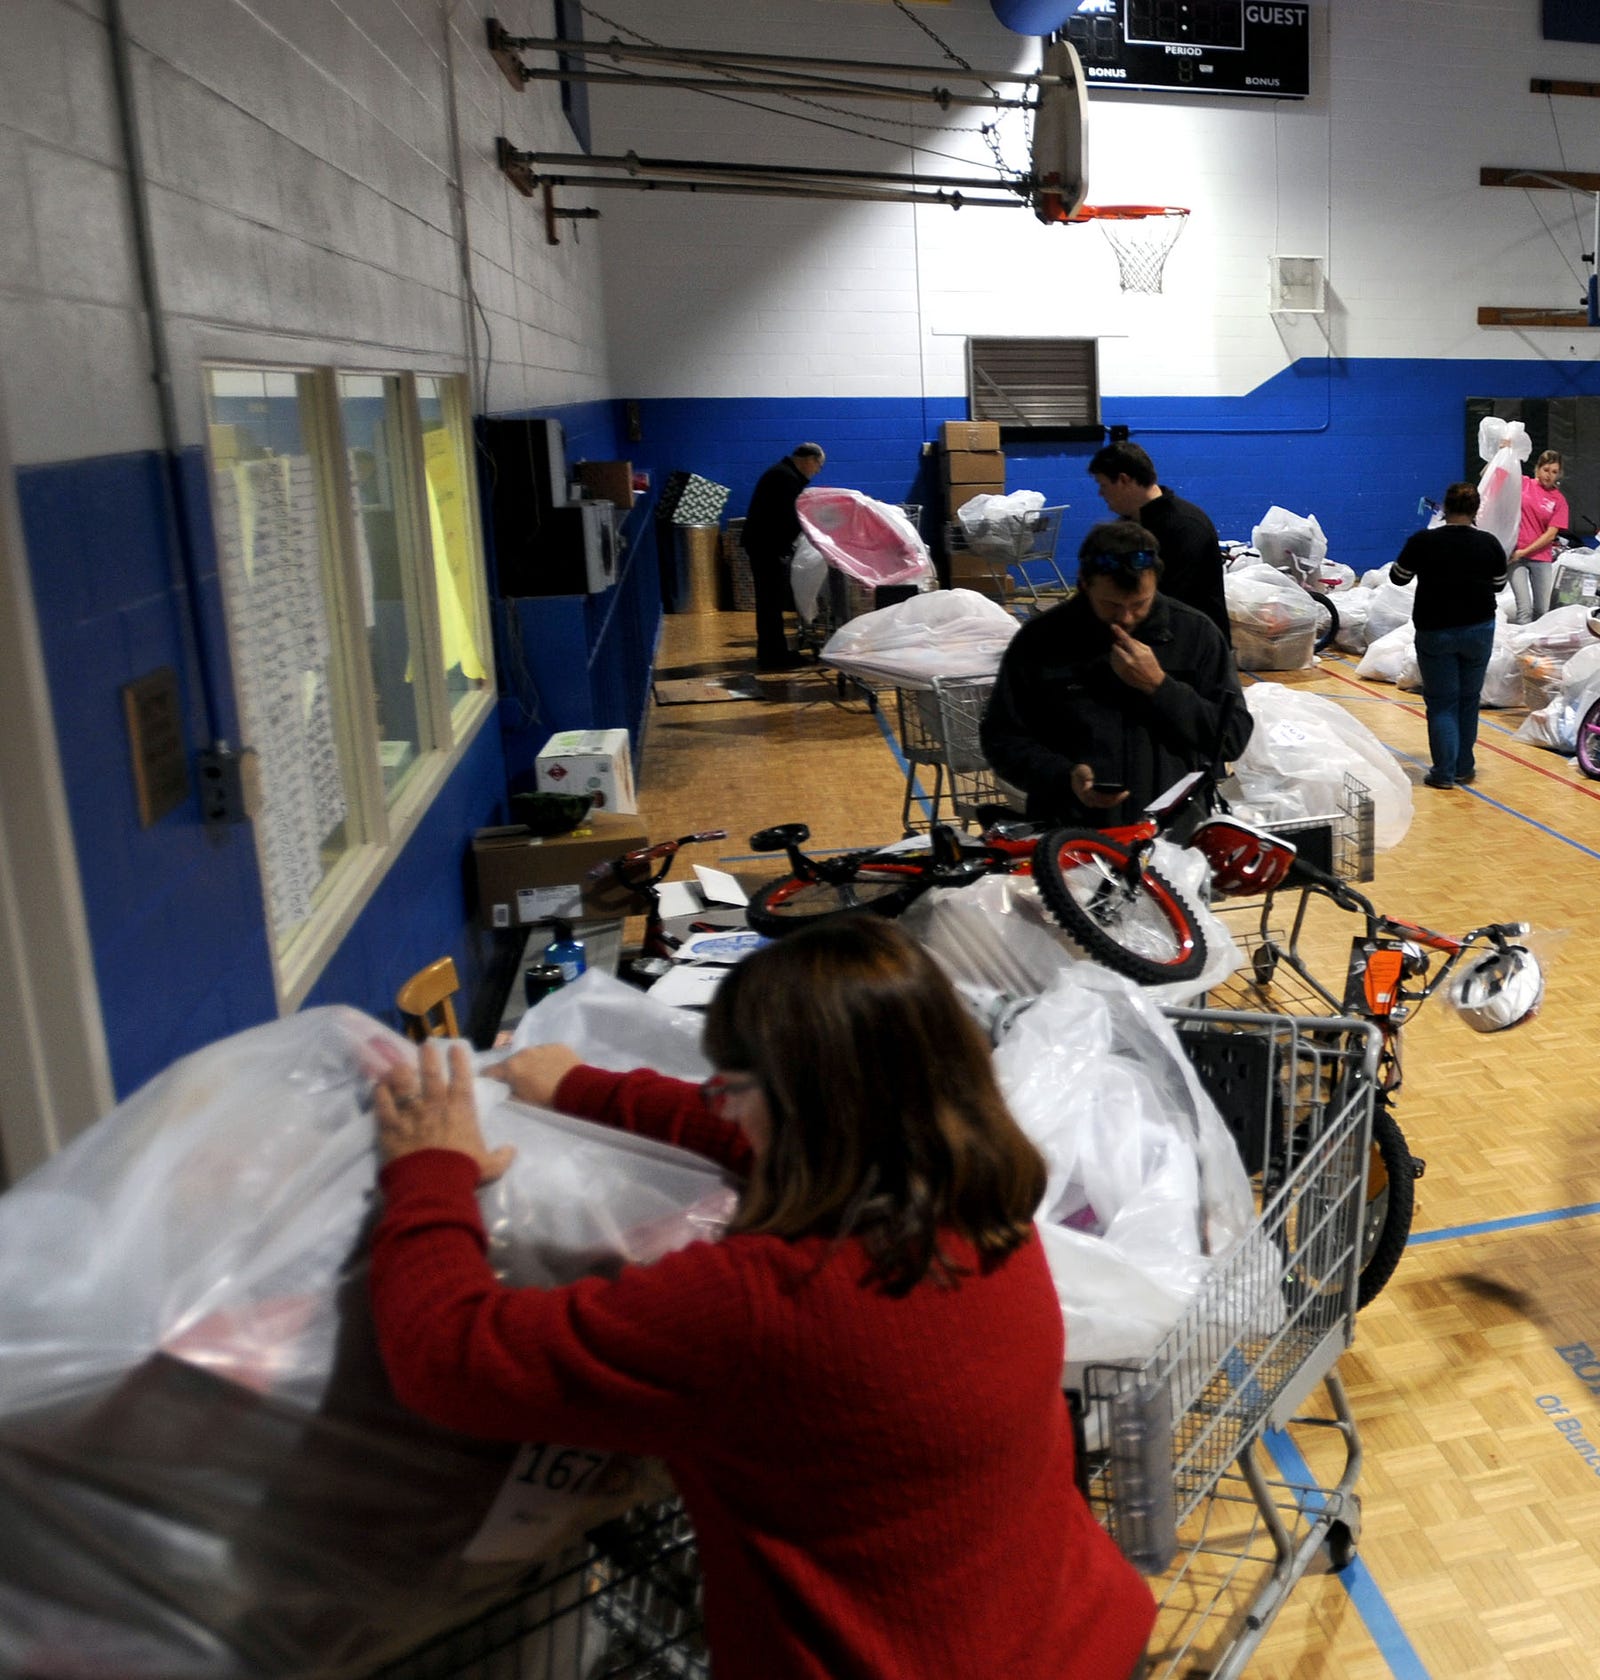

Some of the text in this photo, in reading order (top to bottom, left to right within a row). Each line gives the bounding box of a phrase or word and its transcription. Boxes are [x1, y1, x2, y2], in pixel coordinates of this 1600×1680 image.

[1246, 5, 1307, 27] GUEST
[1165, 46, 1203, 56] PERIOD
[1088, 67, 1127, 78] BONUS
[1245, 76, 1281, 87] BONUS
[1536, 1394, 1569, 1416] Of
[516, 1442, 603, 1494] 167
